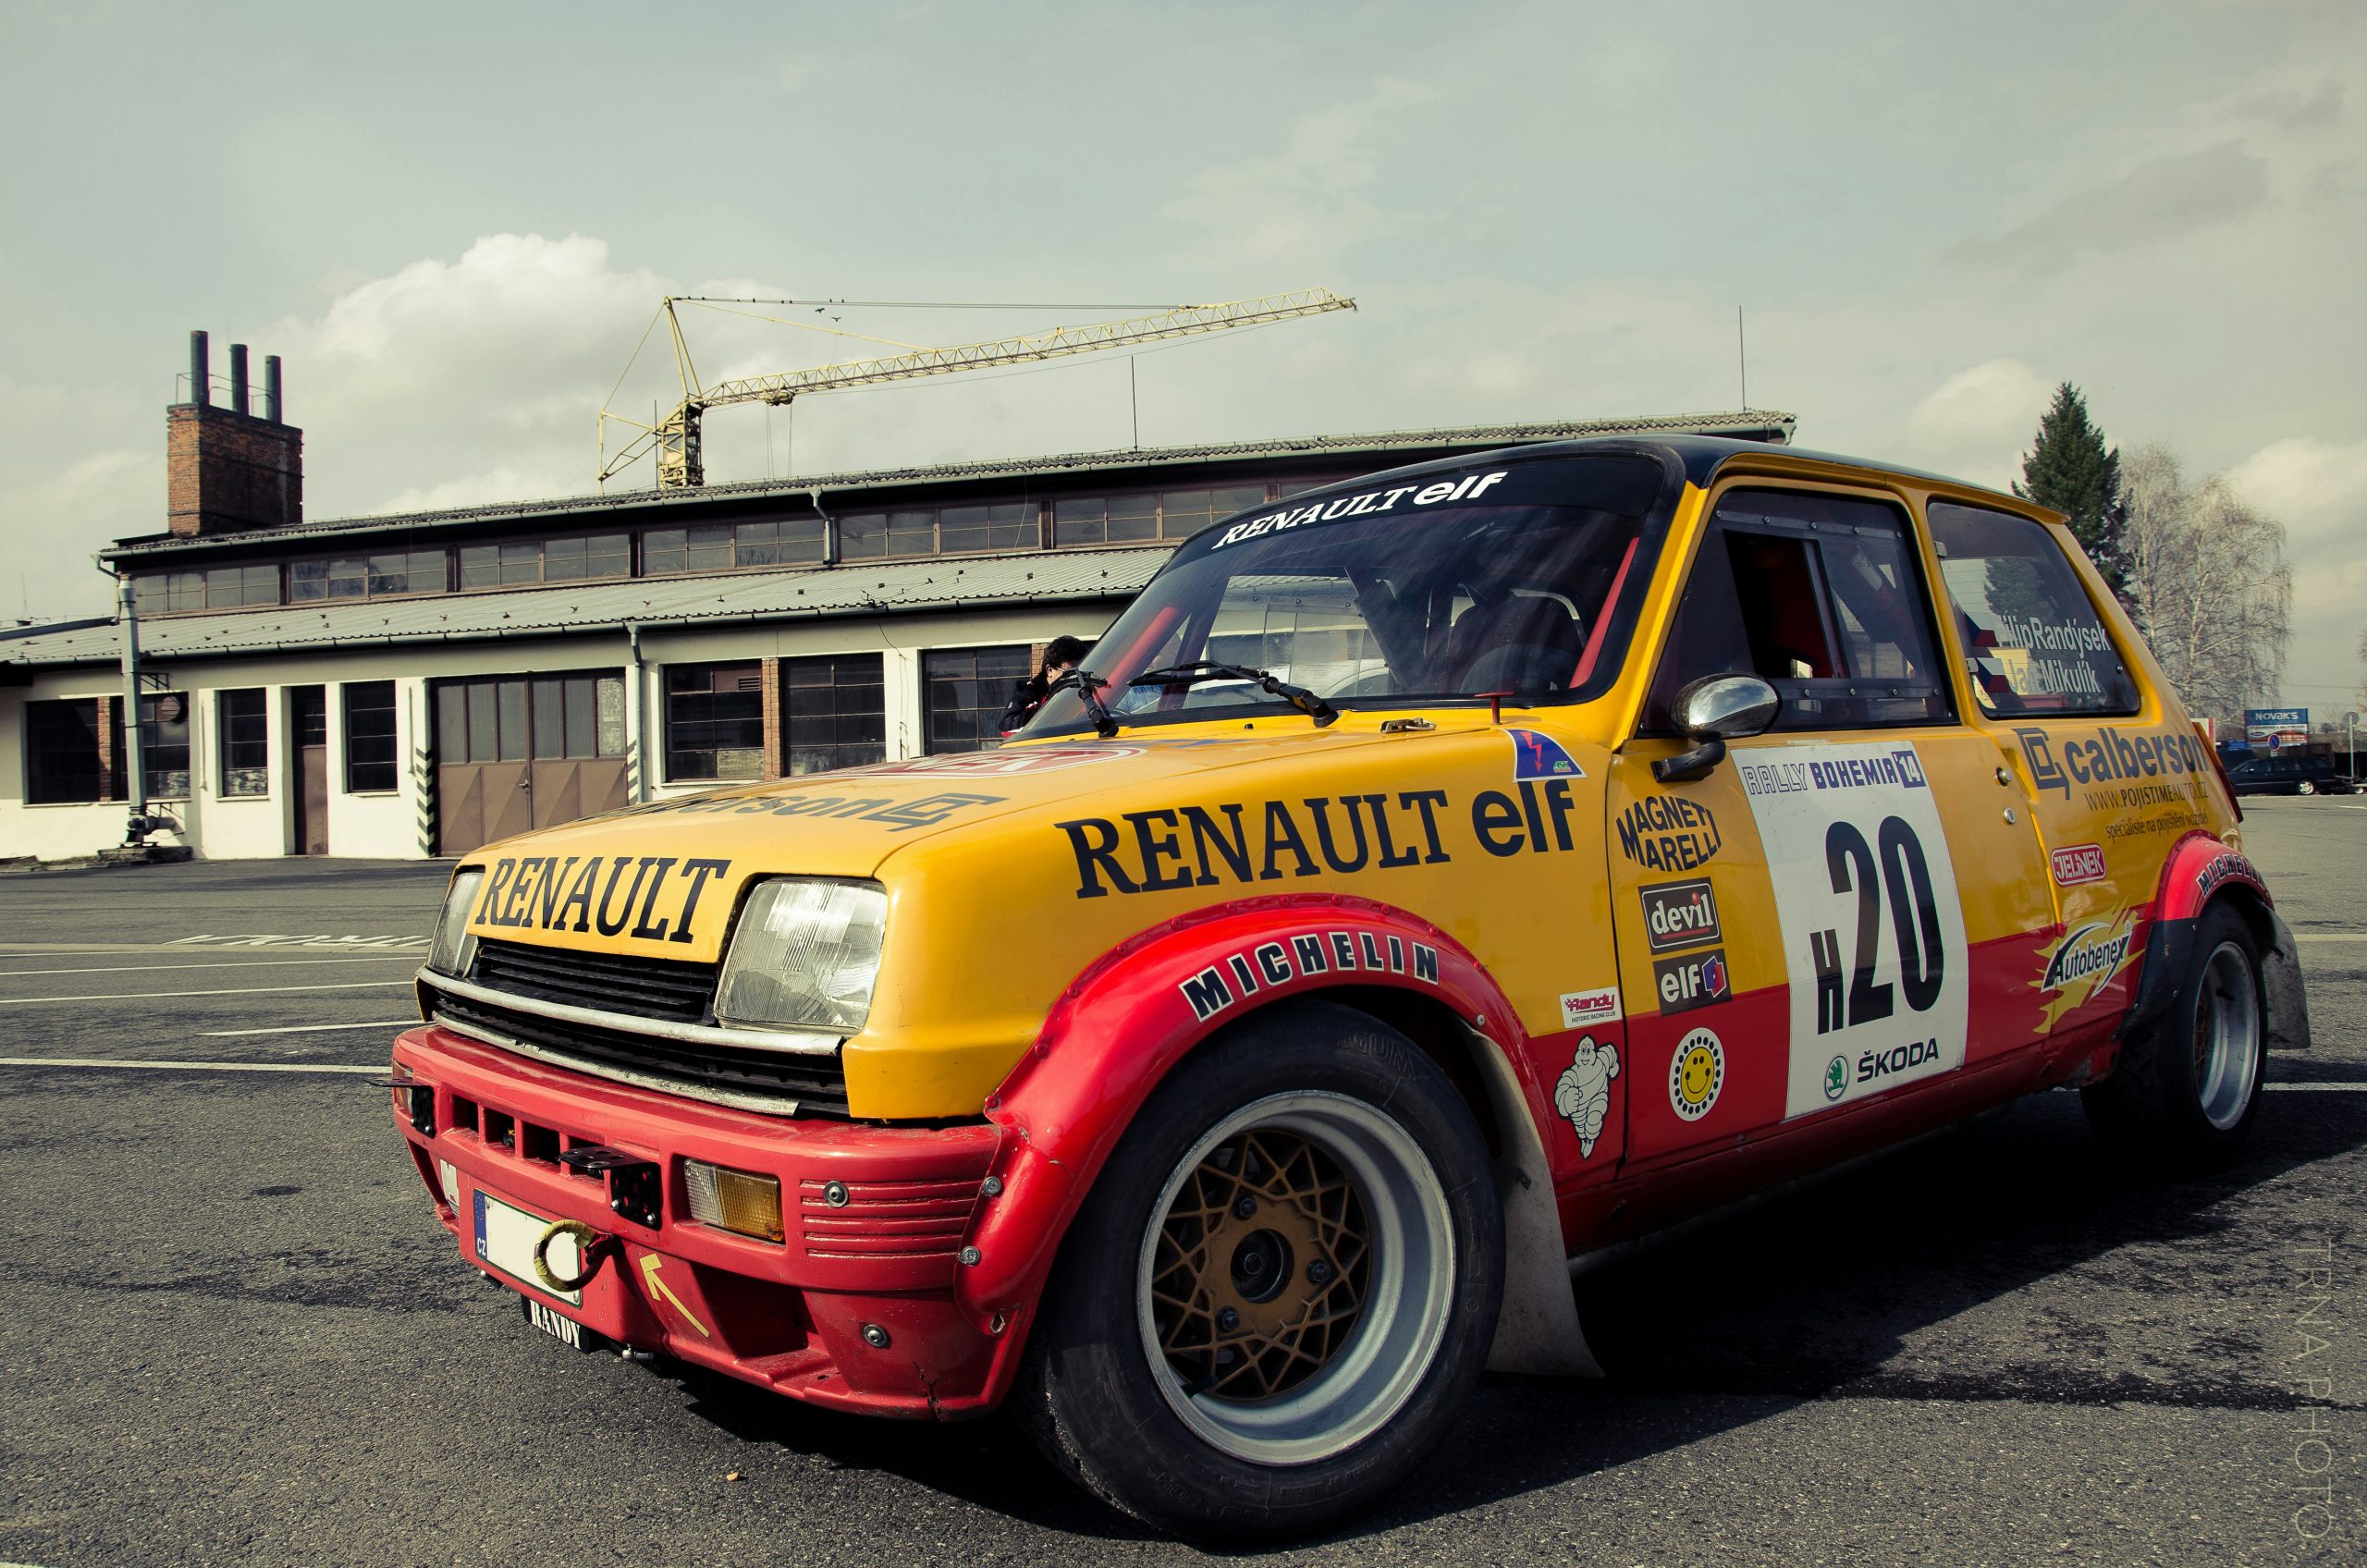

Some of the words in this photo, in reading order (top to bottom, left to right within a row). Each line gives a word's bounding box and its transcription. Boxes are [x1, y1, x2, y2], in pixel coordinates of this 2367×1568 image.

[1211, 485, 1418, 549] RENAULT
[1413, 472, 1508, 506] elf
[2030, 618, 2111, 658] Randýsek
[2039, 659, 2101, 693] Mikulík
[1742, 763, 1808, 795] RALLY
[1809, 757, 1899, 790] BOHEMIA
[2065, 728, 2210, 784] calberson
[1053, 790, 1452, 899] RENAULT
[1471, 778, 1576, 858] elf
[1616, 796, 1722, 846] MAGNETI
[1616, 818, 1722, 872] MARELLI
[475, 856, 731, 944] RENAULT
[1651, 892, 1713, 935] devil
[1178, 932, 1439, 1023] MICHELIN
[1661, 963, 1700, 1003] elf
[2042, 932, 2132, 993] Autobenex
[1564, 994, 1614, 1012] Randy
[1858, 1037, 1939, 1083] ŠKODA
[477, 1236, 486, 1256] CZ
[530, 1298, 581, 1351] RANDY
